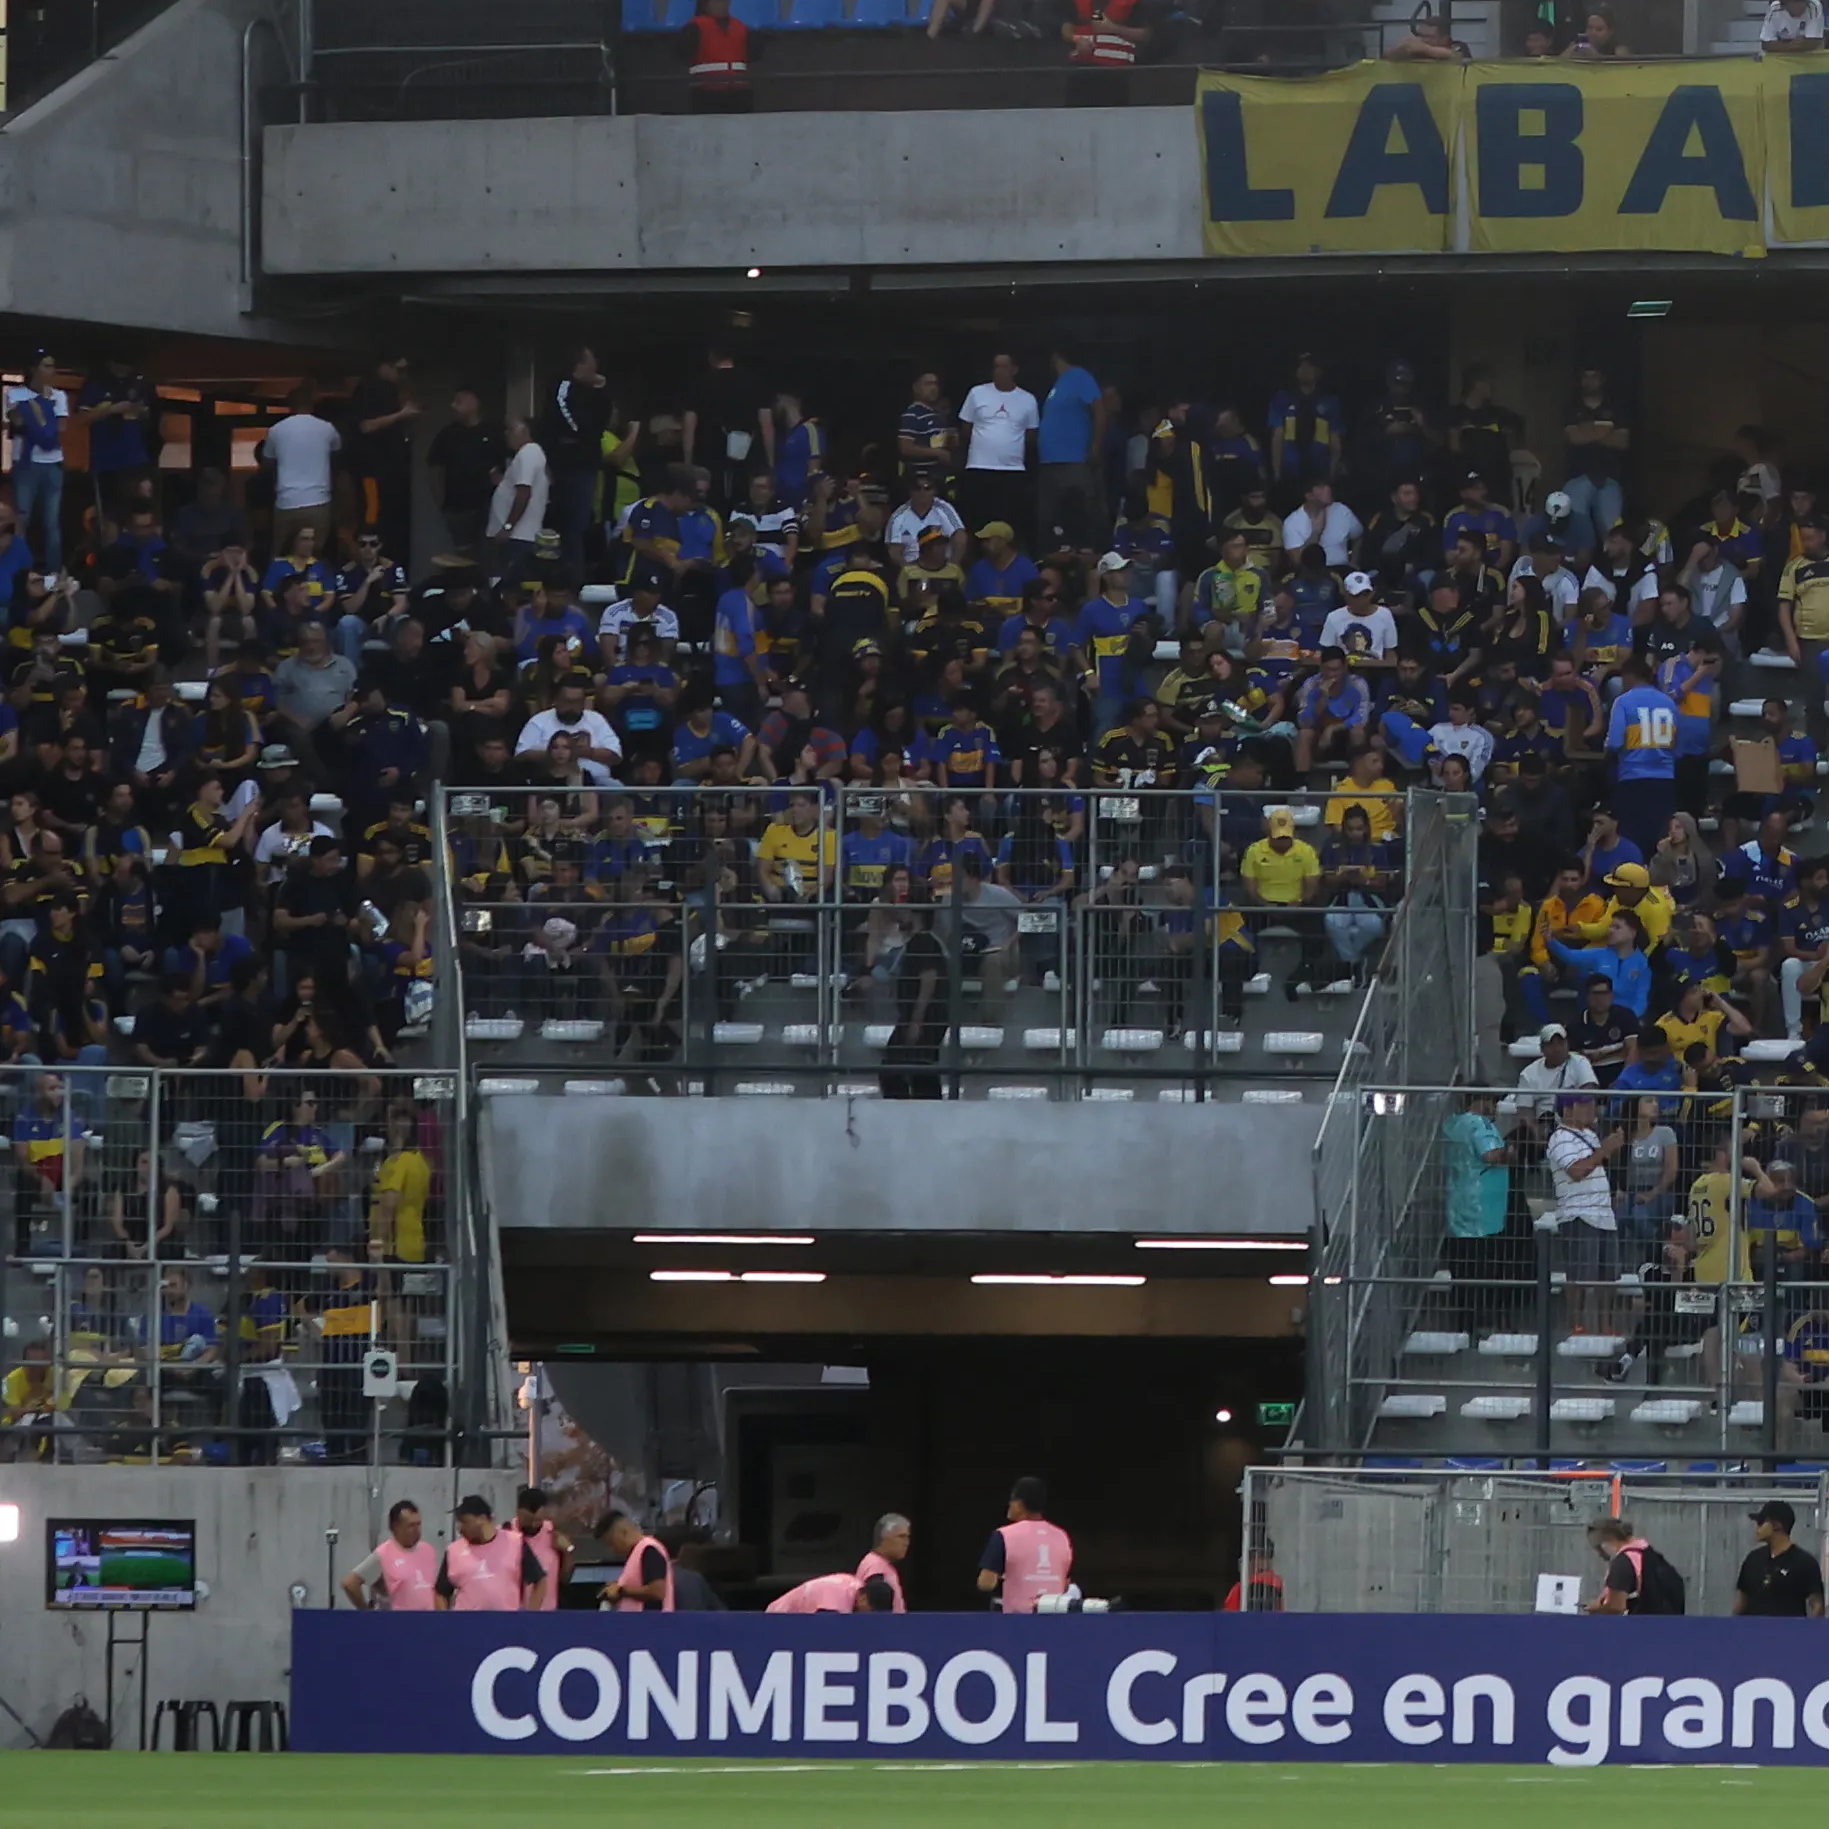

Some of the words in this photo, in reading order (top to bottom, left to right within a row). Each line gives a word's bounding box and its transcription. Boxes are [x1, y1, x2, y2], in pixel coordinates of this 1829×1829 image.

[1203, 83, 1450, 222] LA
[1637, 706, 1674, 746] 10
[471, 1646, 1079, 1745] CONMEBOL
[1106, 1649, 1355, 1746] Cree
[1383, 1673, 1516, 1746] en
